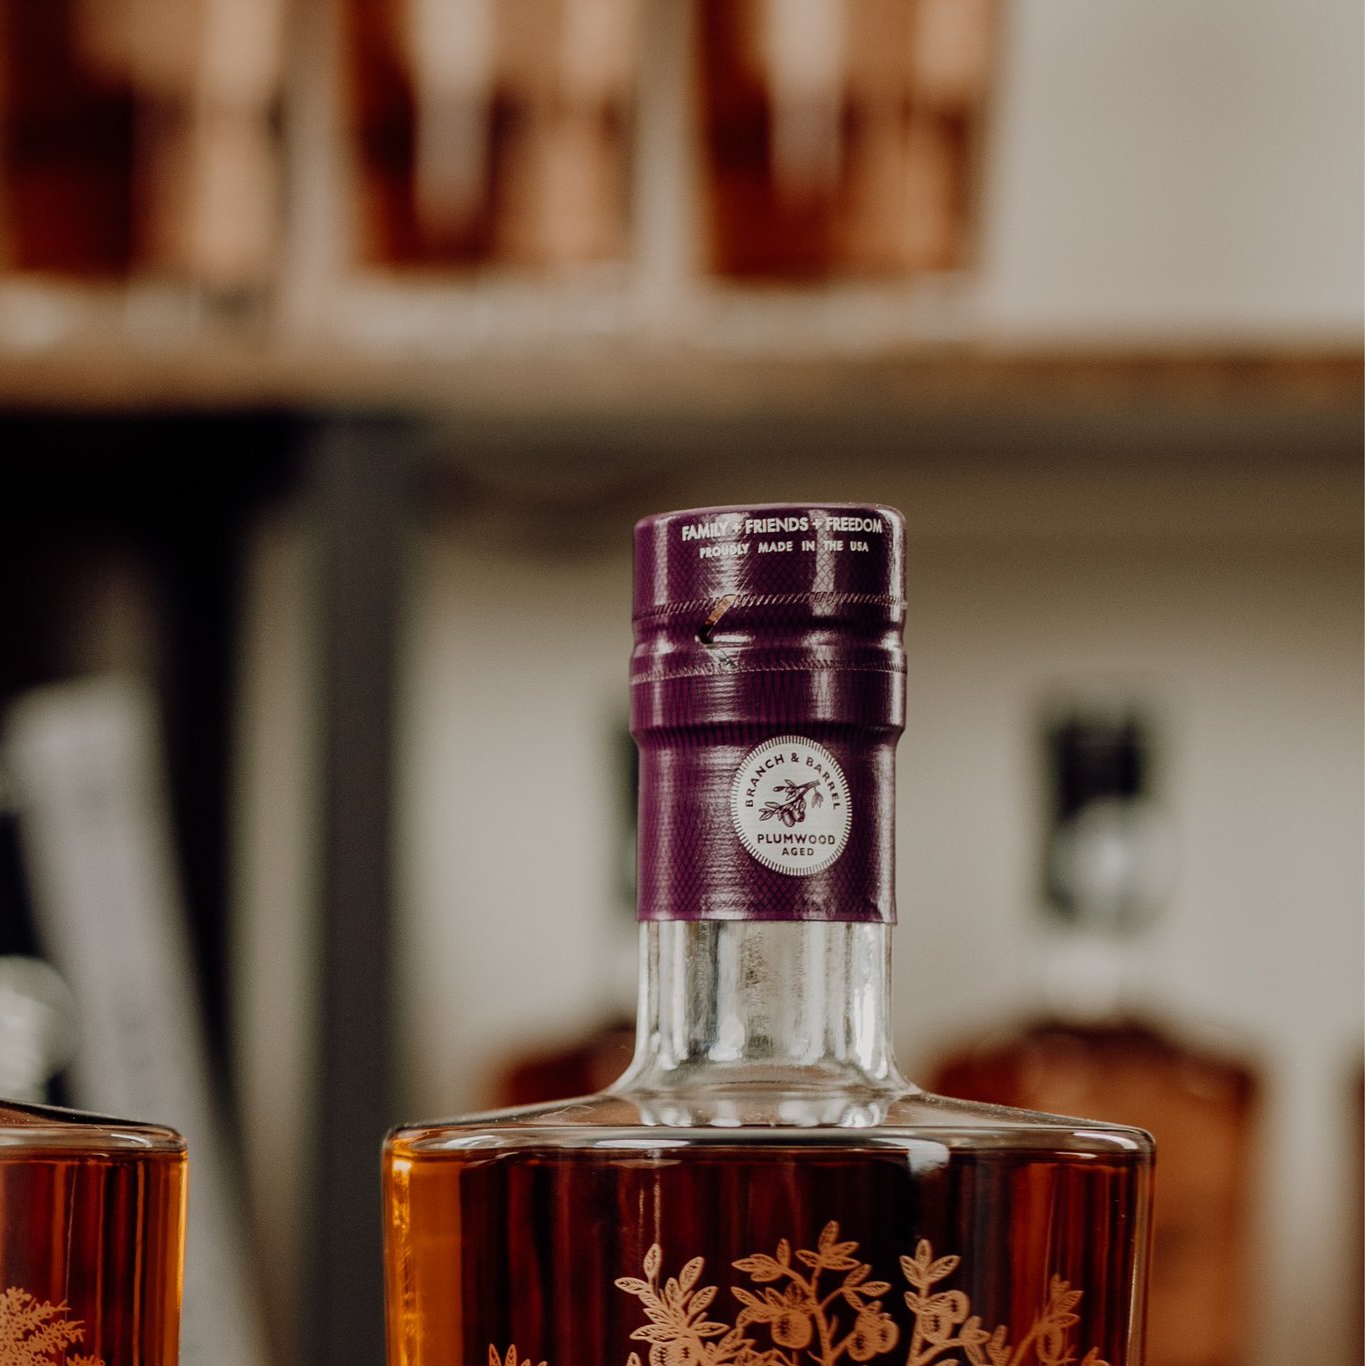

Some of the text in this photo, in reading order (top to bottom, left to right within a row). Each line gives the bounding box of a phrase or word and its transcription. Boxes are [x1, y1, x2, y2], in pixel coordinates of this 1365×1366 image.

[682, 521, 727, 541] FAMILY
[745, 518, 809, 534] FRIENDS
[826, 517, 883, 533] FREEDOM
[699, 541, 869, 559] PROUDLY MADE IN THE USA
[745, 752, 840, 810] BRANCH & BARREL
[757, 834, 835, 844] PLUMWOOD
[782, 847, 814, 856] AGED
